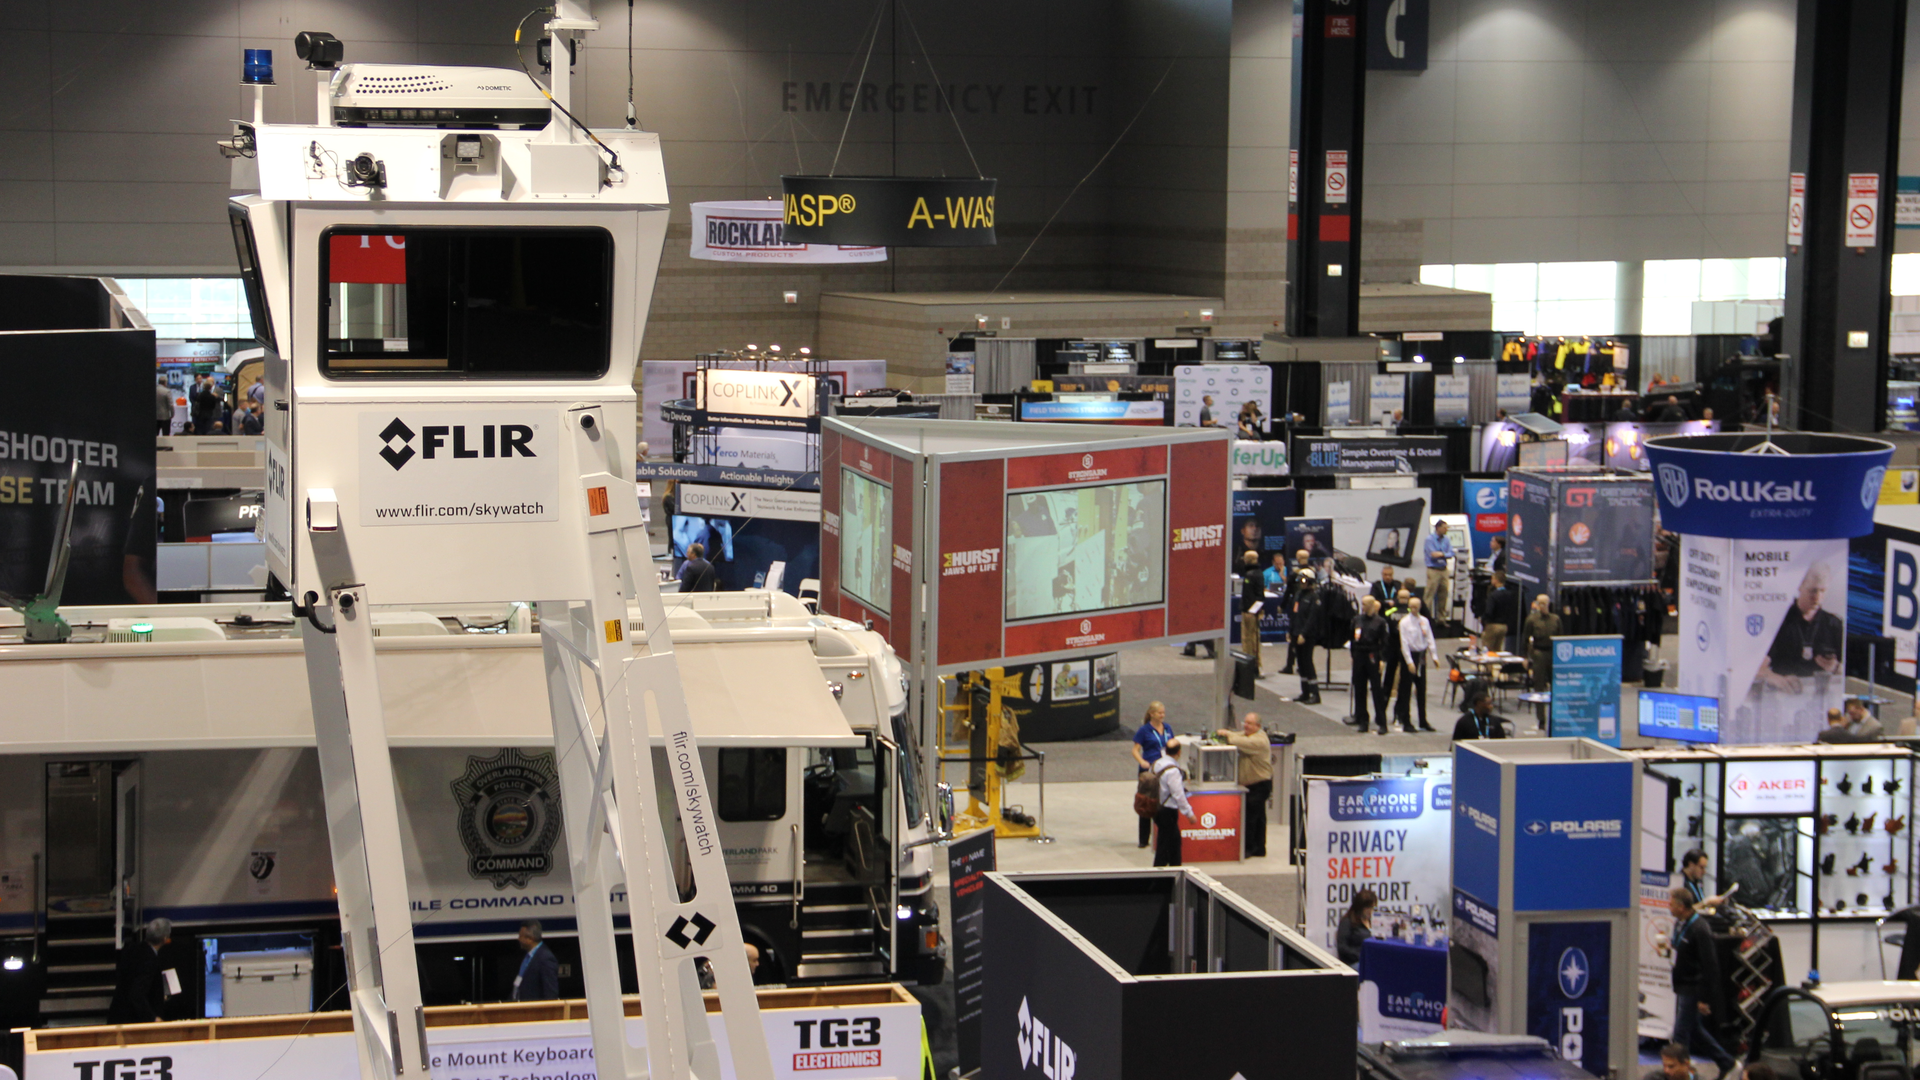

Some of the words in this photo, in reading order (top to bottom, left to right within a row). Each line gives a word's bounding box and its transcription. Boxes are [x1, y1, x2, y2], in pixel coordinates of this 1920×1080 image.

[1332, 18, 1349, 26] FIRE
[1331, 27, 1350, 35] HOSE
[782, 81, 1003, 114] EMERGENCY
[1023, 85, 1098, 115] EXIT
[671, 411, 692, 422] Device
[1081, 406, 1125, 414] STREAMLINED
[740, 449, 776, 460] Materials
[1341, 448, 1369, 458] Simple
[1369, 448, 1408, 457] Overtime
[1408, 447, 1416, 456] &
[1417, 448, 1442, 457] Detail
[1310, 452, 1339, 467] BLUE
[1341, 459, 1395, 470] Management
[658, 466, 698, 478] Solutions
[720, 471, 762, 482] Actionable
[763, 474, 794, 486] Insights
[273, 458, 285, 501] FLIR
[1601, 486, 1651, 498] GENERAL
[1694, 477, 1816, 502] RollKall
[375, 502, 544, 518] www.flir.com/skywatch
[1750, 508, 1812, 518] EXTRA-DUTY
[1181, 524, 1224, 541] HURST
[1172, 541, 1192, 551] JAWS
[1192, 539, 1203, 549] OF
[1204, 538, 1221, 548] LIFE
[952, 548, 1000, 566] HURST
[1745, 551, 1790, 562] MOBILE
[943, 565, 966, 576] JAWS
[967, 564, 978, 573] OF
[979, 563, 998, 572] LIFE
[1745, 567, 1779, 577] FIRST
[1744, 581, 1762, 589] FOR
[1744, 593, 1787, 602] OFFICERS
[1574, 646, 1616, 657] RollKall
[476, 768, 521, 787] OVERLAND
[523, 770, 544, 785] PARK
[494, 780, 526, 791] POLICE
[1758, 780, 1806, 790] AKER
[672, 731, 714, 857] flir.com/skywatch
[1338, 795, 1364, 807] EAR
[1369, 793, 1418, 806] PHONE
[1338, 805, 1418, 815] CONNECTION
[1467, 806, 1498, 830] POLARIS
[1550, 819, 1622, 834] POLARIS
[1328, 829, 1408, 854] PRIVACY
[476, 857, 544, 871] COMMAND
[965, 864, 972, 873] IN
[1327, 856, 1395, 880] SAFETY
[760, 884, 778, 893] 40
[410, 901, 442, 911] ILE
[450, 894, 564, 910] COMMAND
[1465, 900, 1496, 926] POLARIS
[1388, 994, 1412, 1007] EAR
[794, 1016, 881, 1050] TG3
[1562, 1006, 1583, 1069] PO
[448, 1052, 507, 1067] Mount
[795, 1050, 879, 1070] ELECTRONICS
[73, 1056, 173, 1080] TG3
